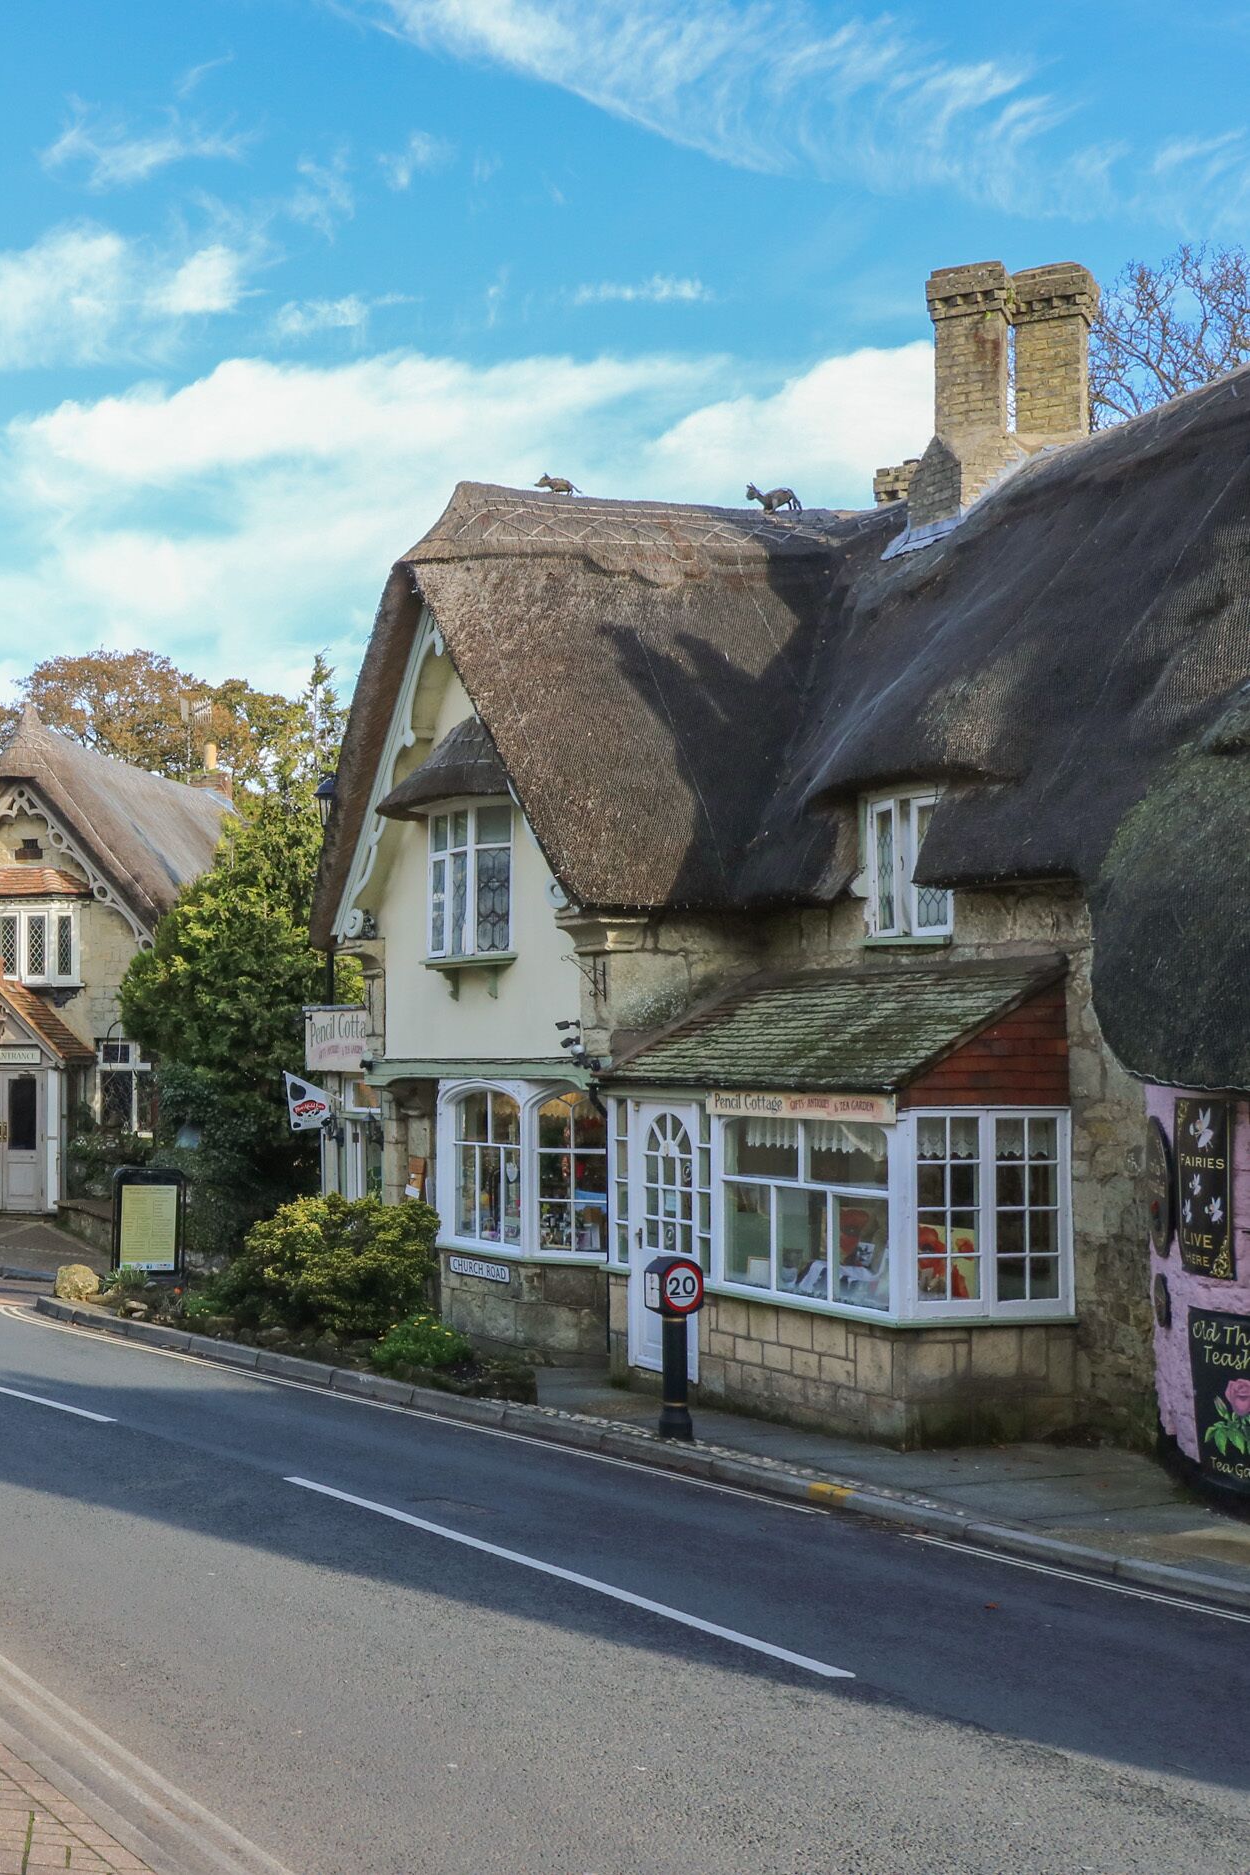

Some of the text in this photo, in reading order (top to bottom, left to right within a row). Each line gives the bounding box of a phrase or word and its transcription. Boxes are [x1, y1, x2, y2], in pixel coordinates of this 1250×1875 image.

[310, 1014, 335, 1047] Pencil
[714, 1093, 741, 1109] Pencil
[744, 1094, 783, 1113] Cottage
[840, 1101, 850, 1111] TEA
[851, 1100, 874, 1112] GARDEN
[1180, 1153, 1226, 1170] FAIRIES
[1183, 1227, 1214, 1249] LIVE
[453, 1258, 507, 1280] CHURCH ROAD
[1185, 1252, 1210, 1268] HERE
[669, 1276, 696, 1296] 20
[1193, 1320, 1222, 1342] Old
[1210, 1456, 1234, 1474] Tea
